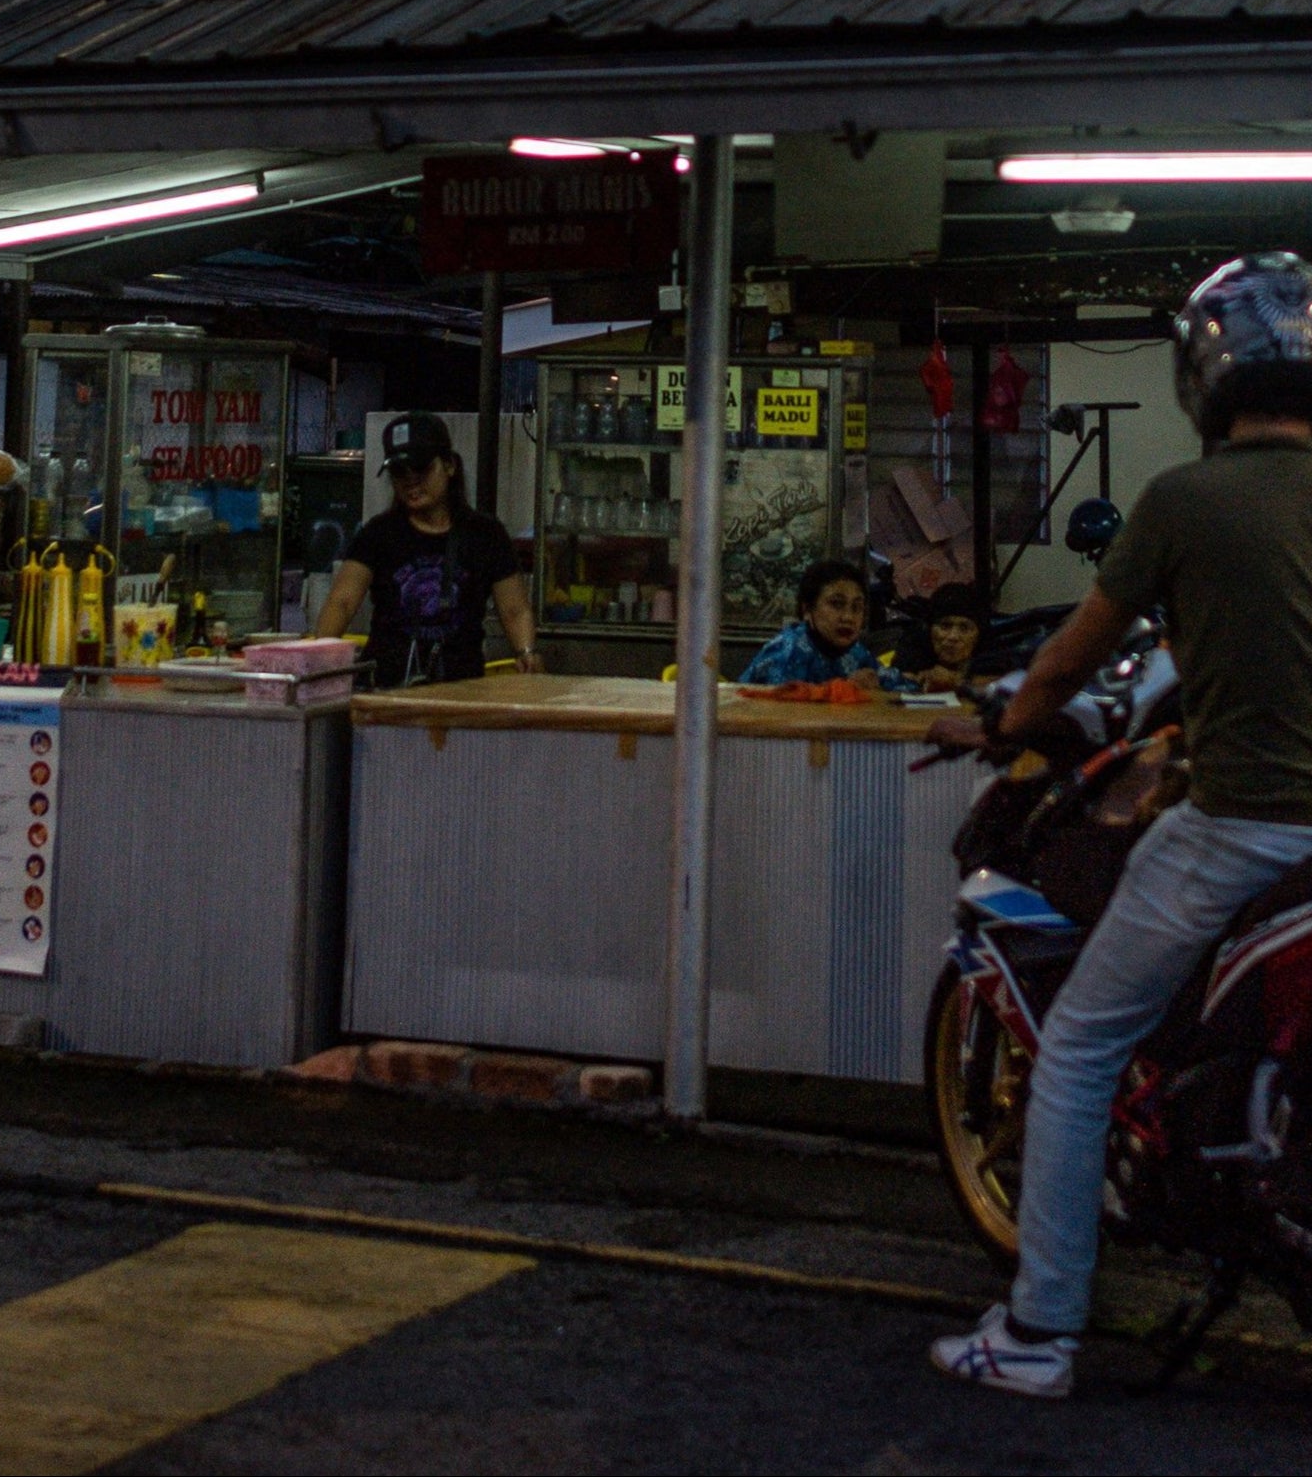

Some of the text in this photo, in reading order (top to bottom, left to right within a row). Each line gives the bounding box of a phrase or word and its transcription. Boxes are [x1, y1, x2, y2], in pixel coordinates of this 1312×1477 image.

[151, 389, 262, 424] TOM YAM
[762, 393, 813, 407] BARLI
[762, 410, 812, 424] MADU
[150, 444, 263, 483] SEAFOOD
